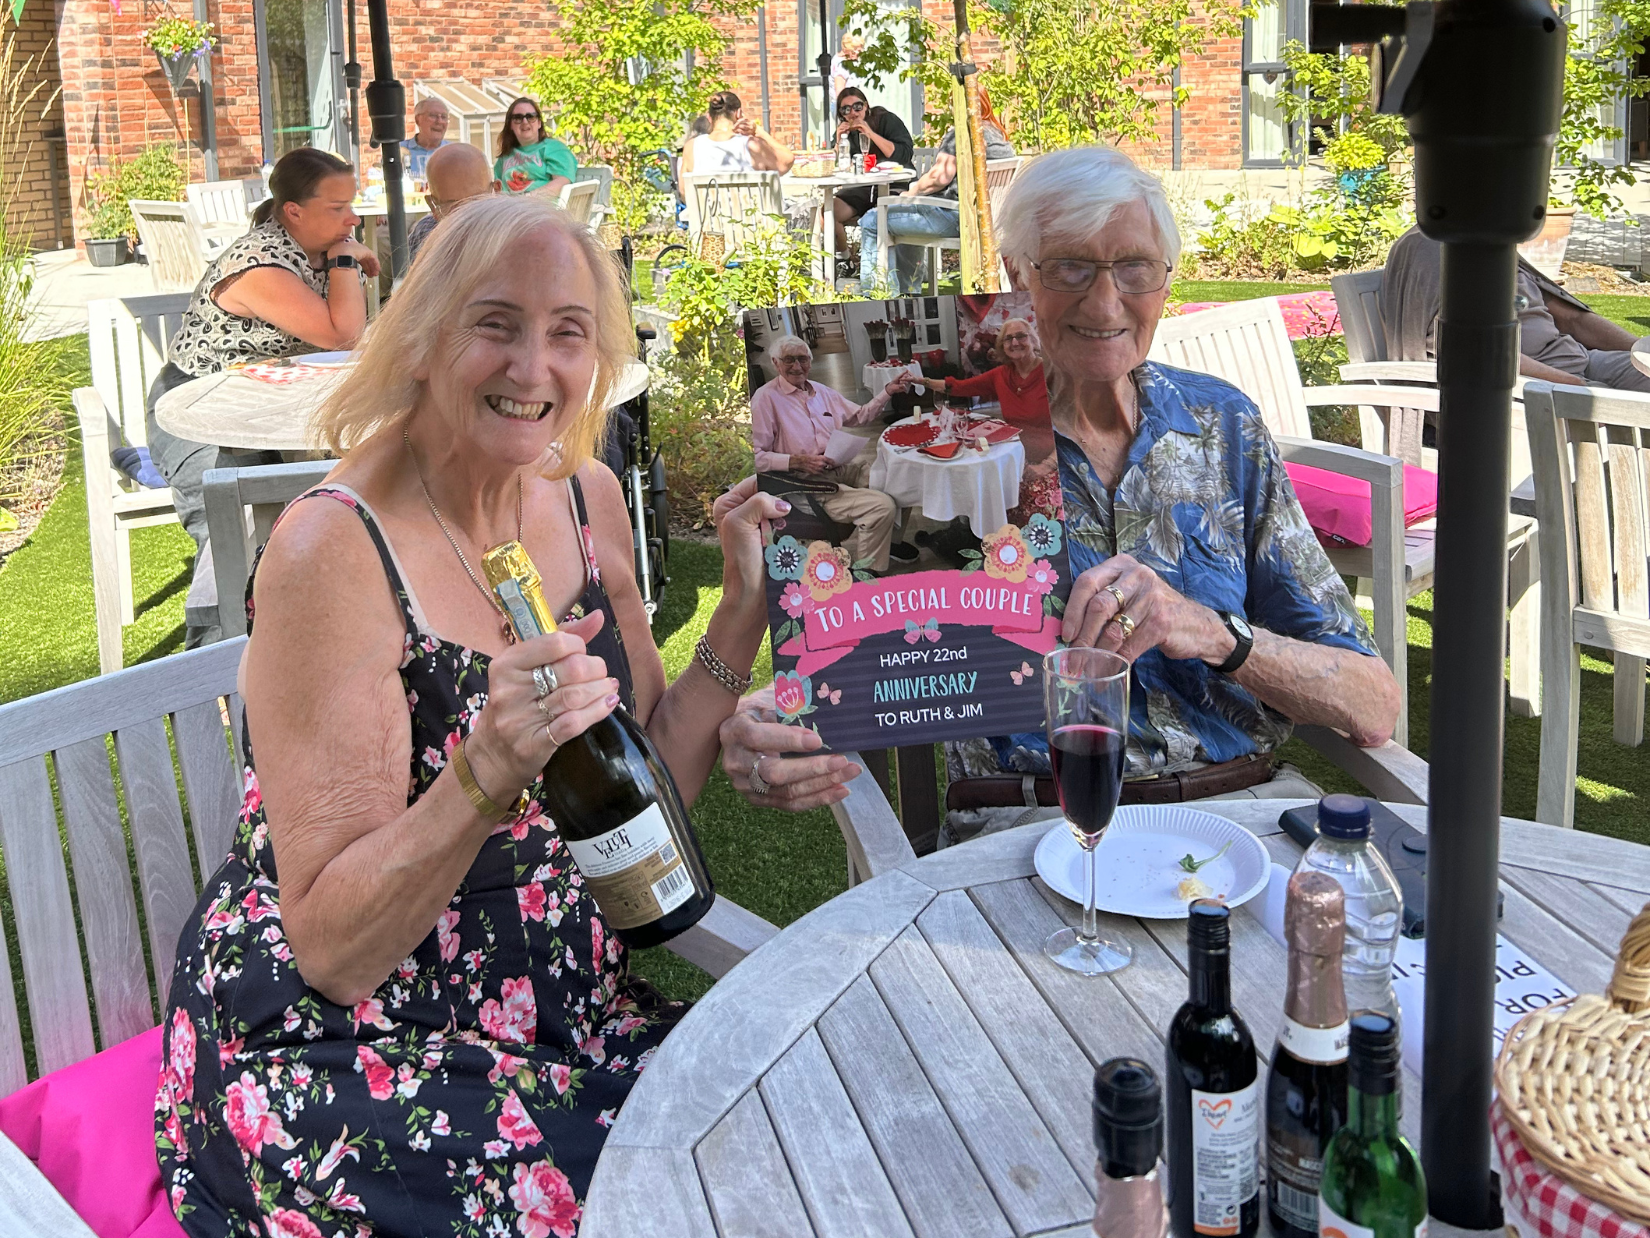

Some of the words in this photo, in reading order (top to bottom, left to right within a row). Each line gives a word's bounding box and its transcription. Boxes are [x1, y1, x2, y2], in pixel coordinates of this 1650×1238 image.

[814, 606, 844, 632] TO
[852, 600, 865, 622] A
[871, 587, 951, 618] SPECIAL
[960, 587, 1034, 616] COUPLE
[880, 650, 930, 668] HAPPY
[932, 646, 968, 662] 22nd
[873, 671, 978, 703] ANNIVERSARY
[875, 712, 897, 727] TO
[899, 708, 941, 725] RUTH
[943, 706, 955, 719] &
[957, 703, 983, 719] JIM
